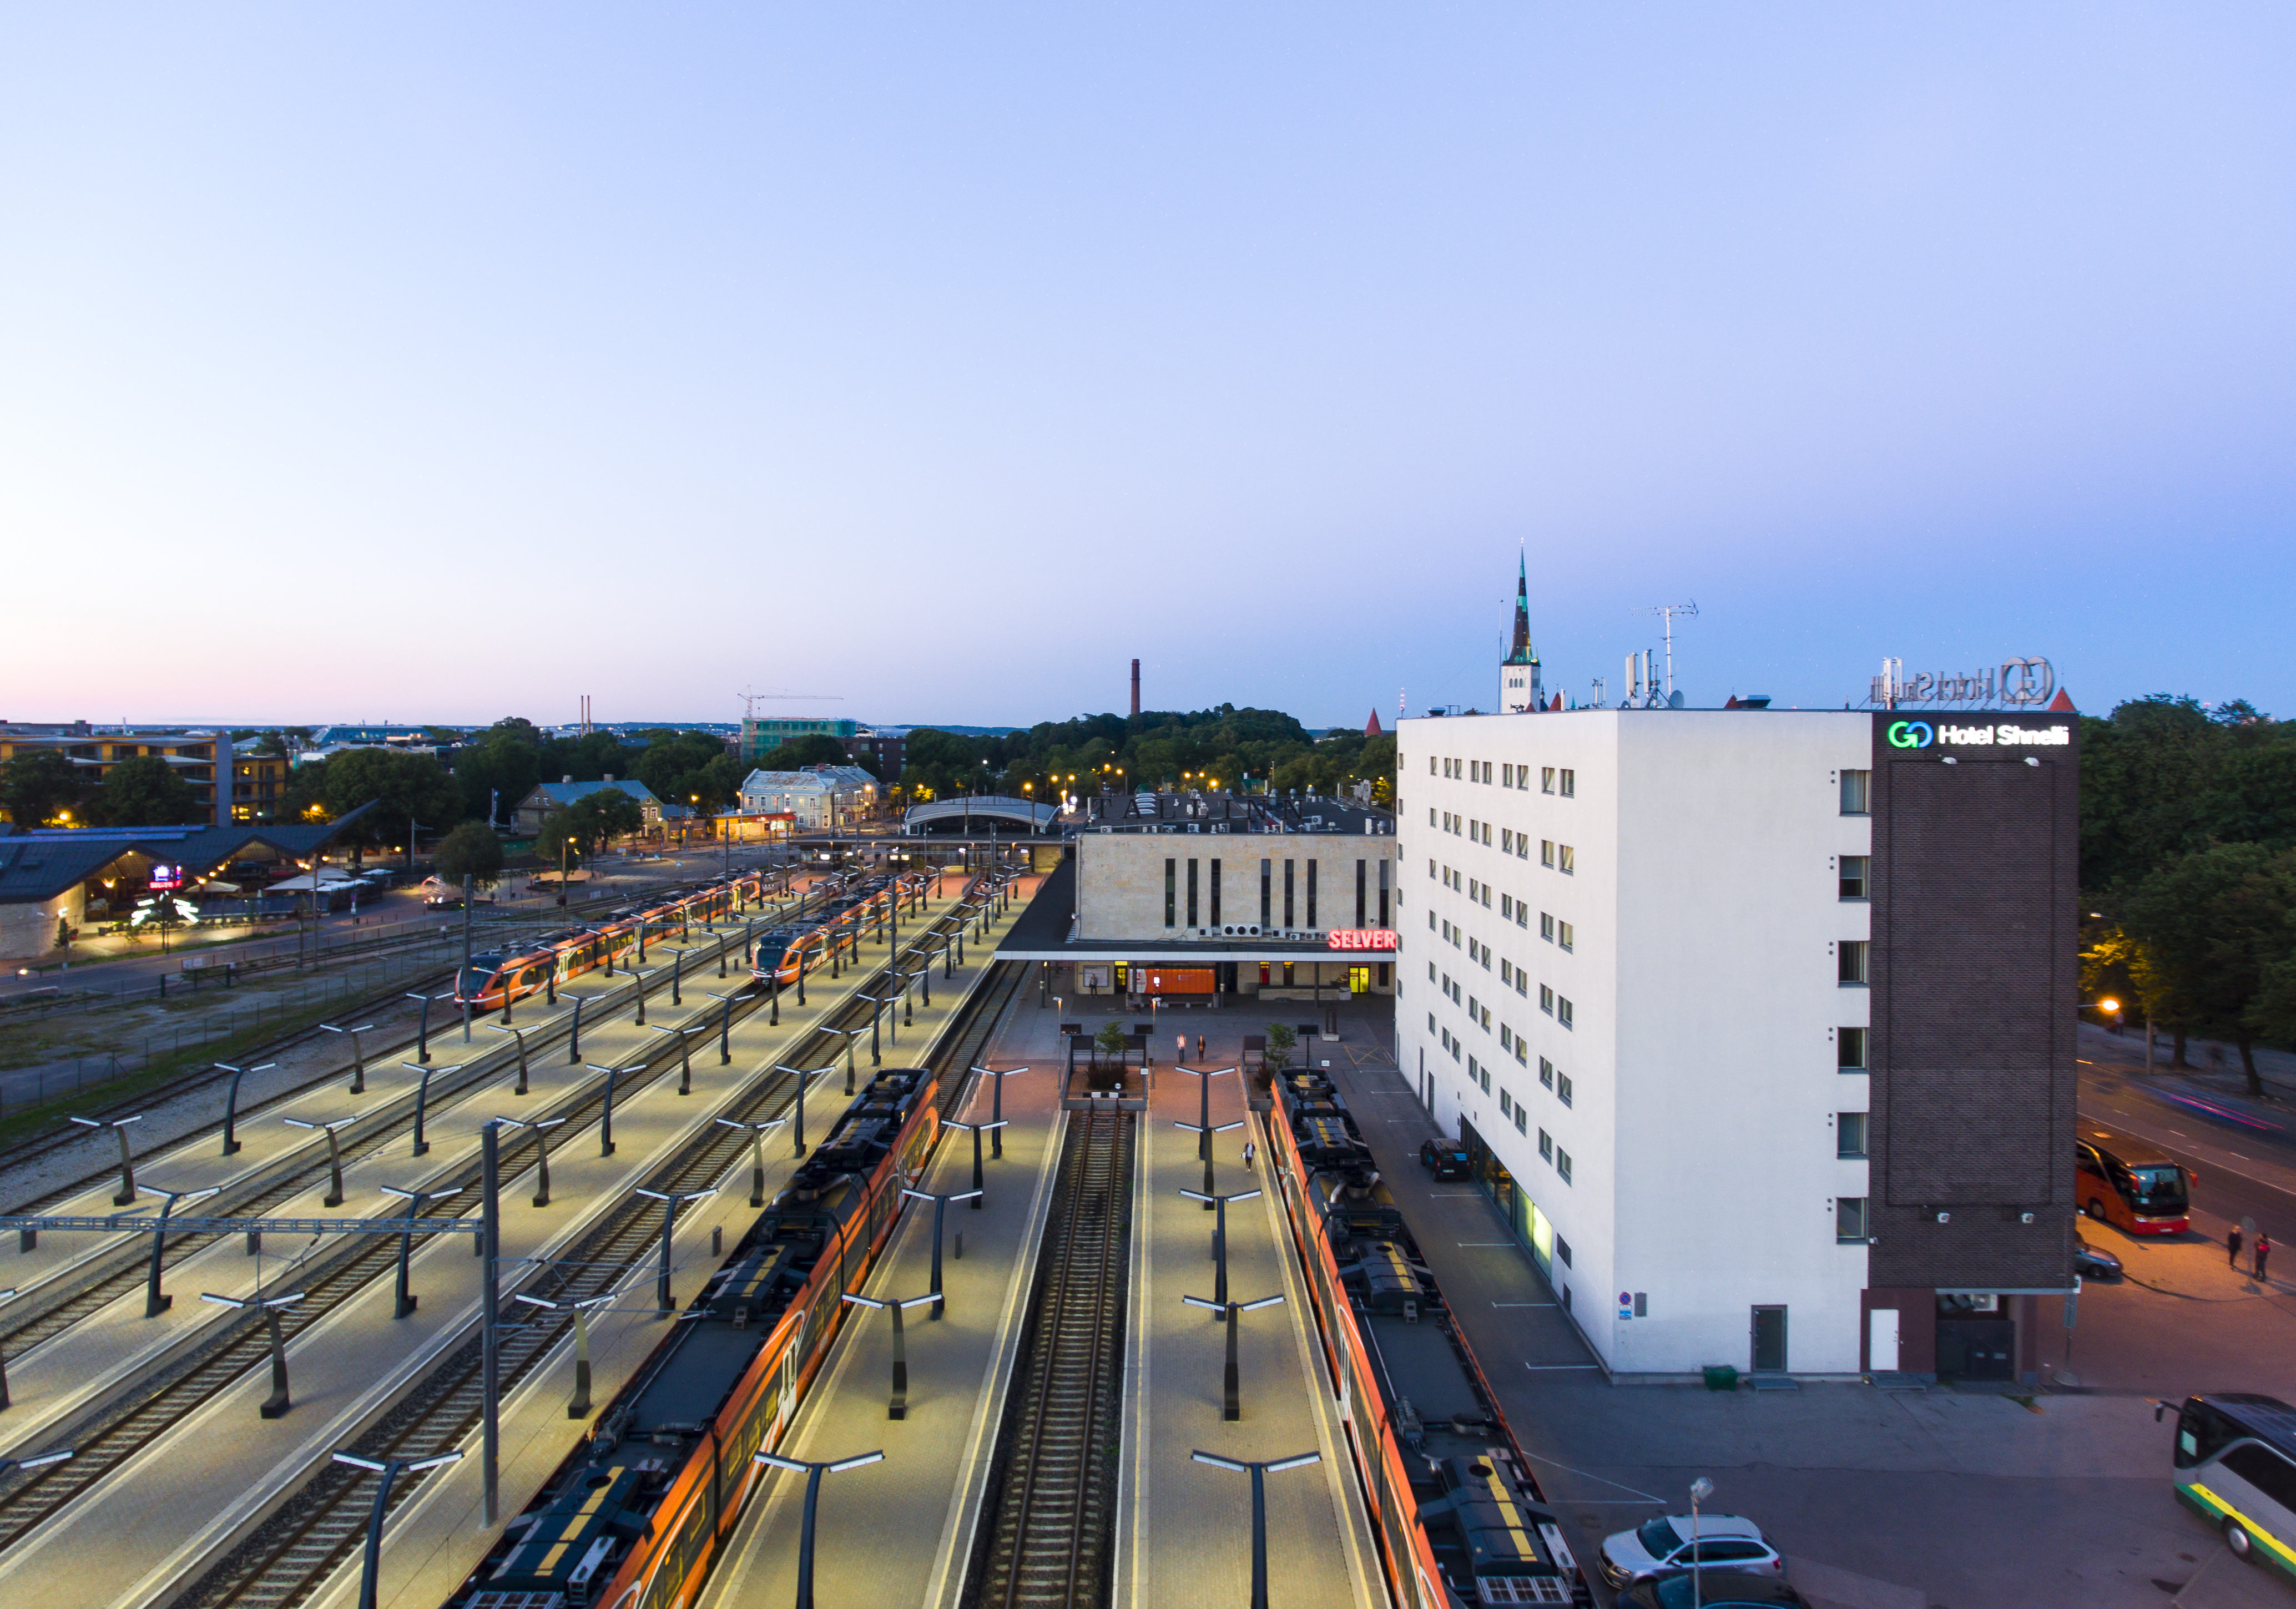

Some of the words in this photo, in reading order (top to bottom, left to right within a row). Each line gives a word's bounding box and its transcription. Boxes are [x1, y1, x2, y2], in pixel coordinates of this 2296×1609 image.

[1939, 725, 1994, 745] Hotel
[1997, 725, 2069, 745] Shnelli
[1093, 798, 1305, 820] TALLINN
[1328, 929, 1396, 949] SELVER
